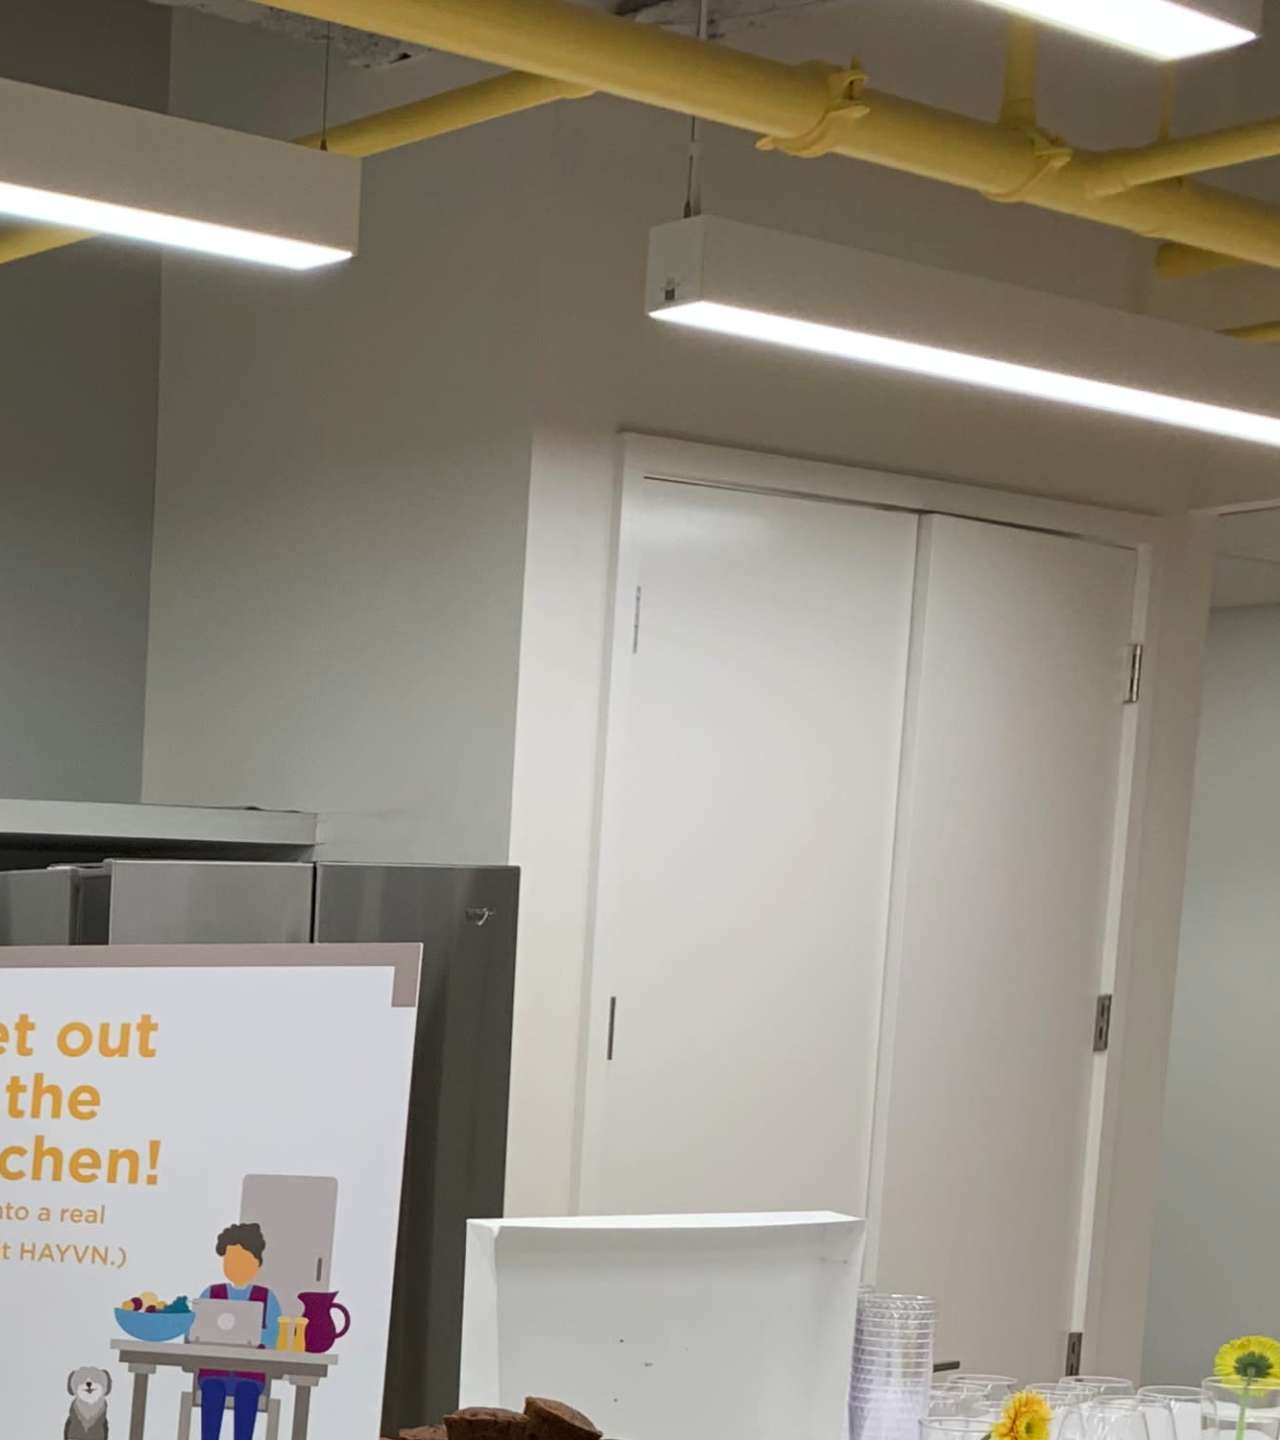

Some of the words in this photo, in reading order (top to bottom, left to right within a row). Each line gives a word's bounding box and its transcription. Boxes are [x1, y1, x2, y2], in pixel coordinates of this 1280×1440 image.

[56, 1012, 160, 1059] out
[6, 1072, 101, 1121] the
[36, 1207, 53, 1224] a
[59, 1203, 105, 1225] real
[19, 1242, 128, 1269] HAYVN.)
